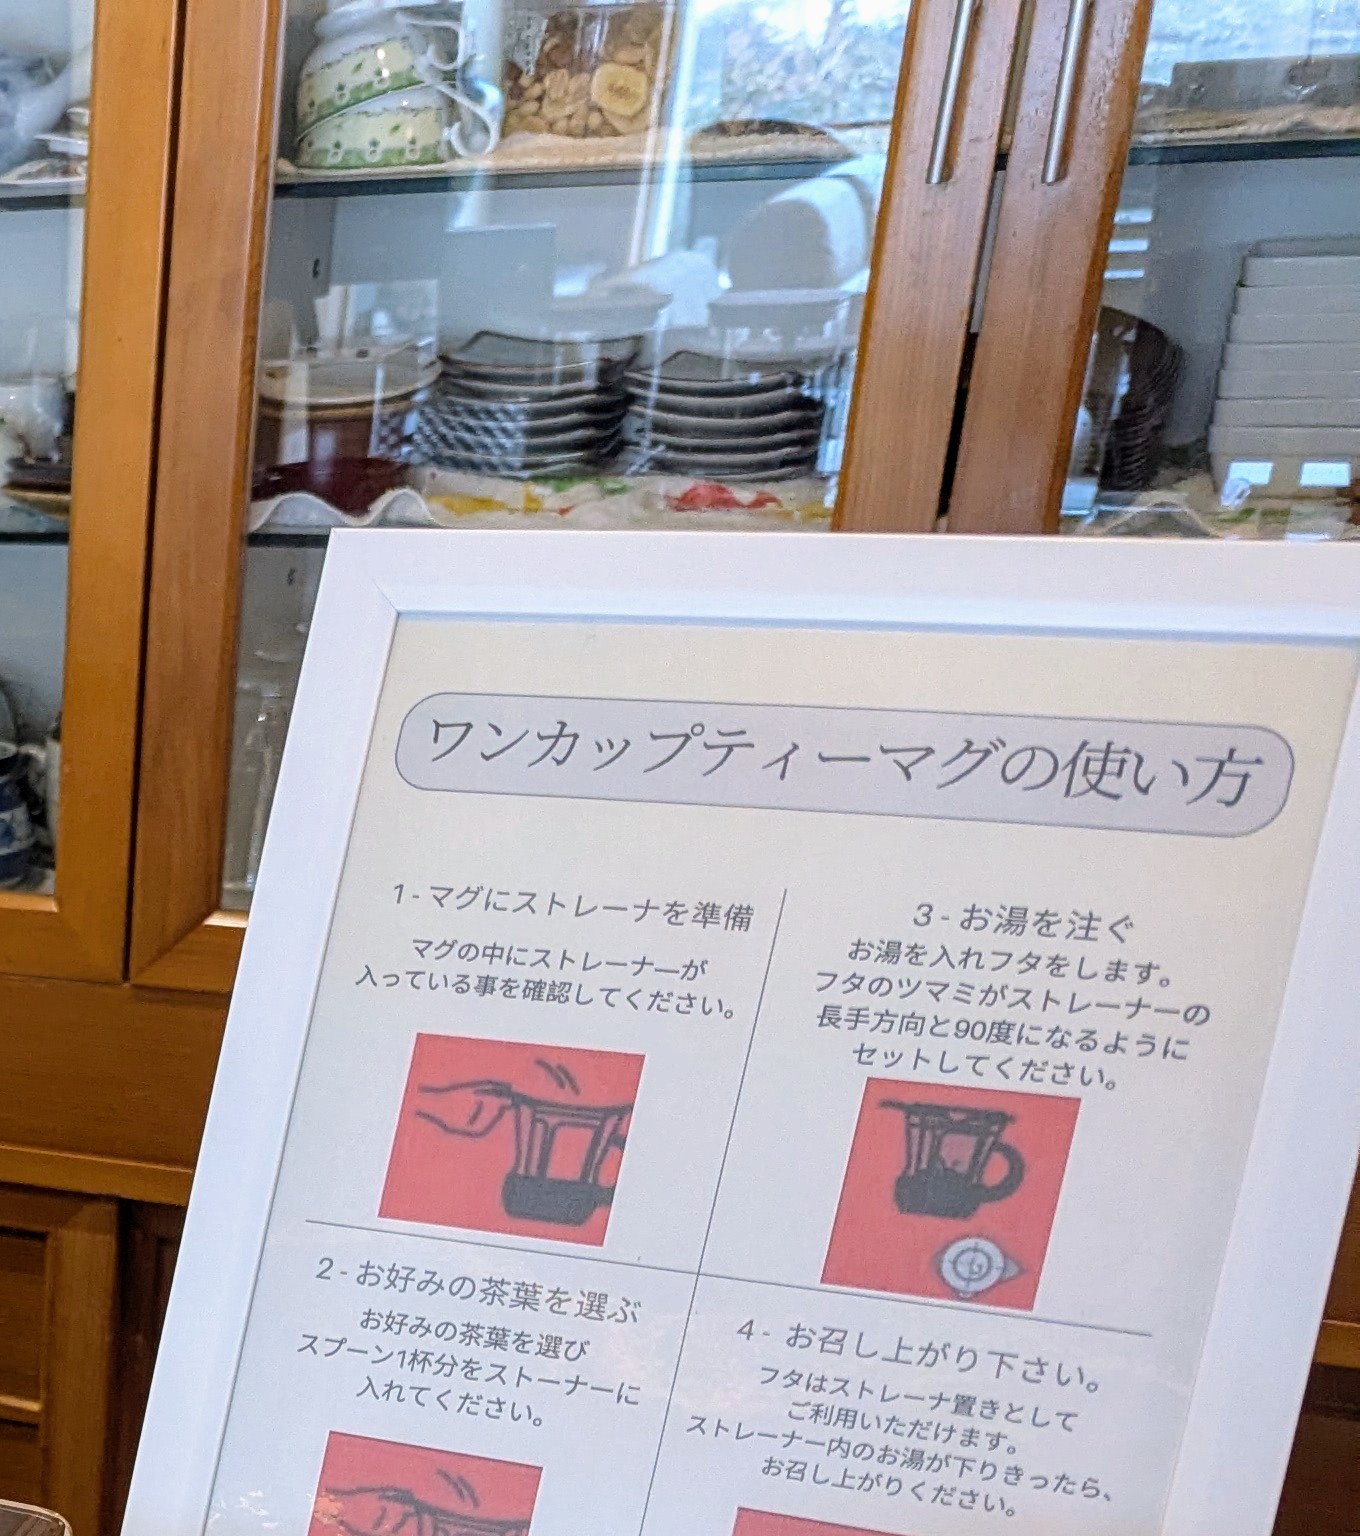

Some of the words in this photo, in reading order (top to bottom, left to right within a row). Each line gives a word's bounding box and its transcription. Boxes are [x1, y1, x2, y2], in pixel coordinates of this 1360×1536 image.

[430, 717, 1266, 809] ワンカップティーマグの使い方
[848, 938, 1171, 988] お湯を入れフタをします。
[355, 964, 734, 1020] 入っている事を確認してください。
[816, 971, 1211, 1027] フタのツマミがストレーナーの
[817, 1004, 1190, 1061] 長手方向と90度になるように
[852, 1042, 1117, 1092] セットしてください。
[360, 1307, 591, 1362] お好みの茶葉を選び
[297, 1333, 641, 1406] スプーン1杯分をストーナーに
[356, 1375, 543, 1428] 入れてください。
[760, 1365, 1079, 1433] フタはストレーナ置きとして
[786, 1400, 1018, 1457] ご利用いただけます。
[686, 1414, 1112, 1502] ストレーナー内のお湯が下りきったら、
[761, 1455, 1018, 1518] お召し上がりください。
